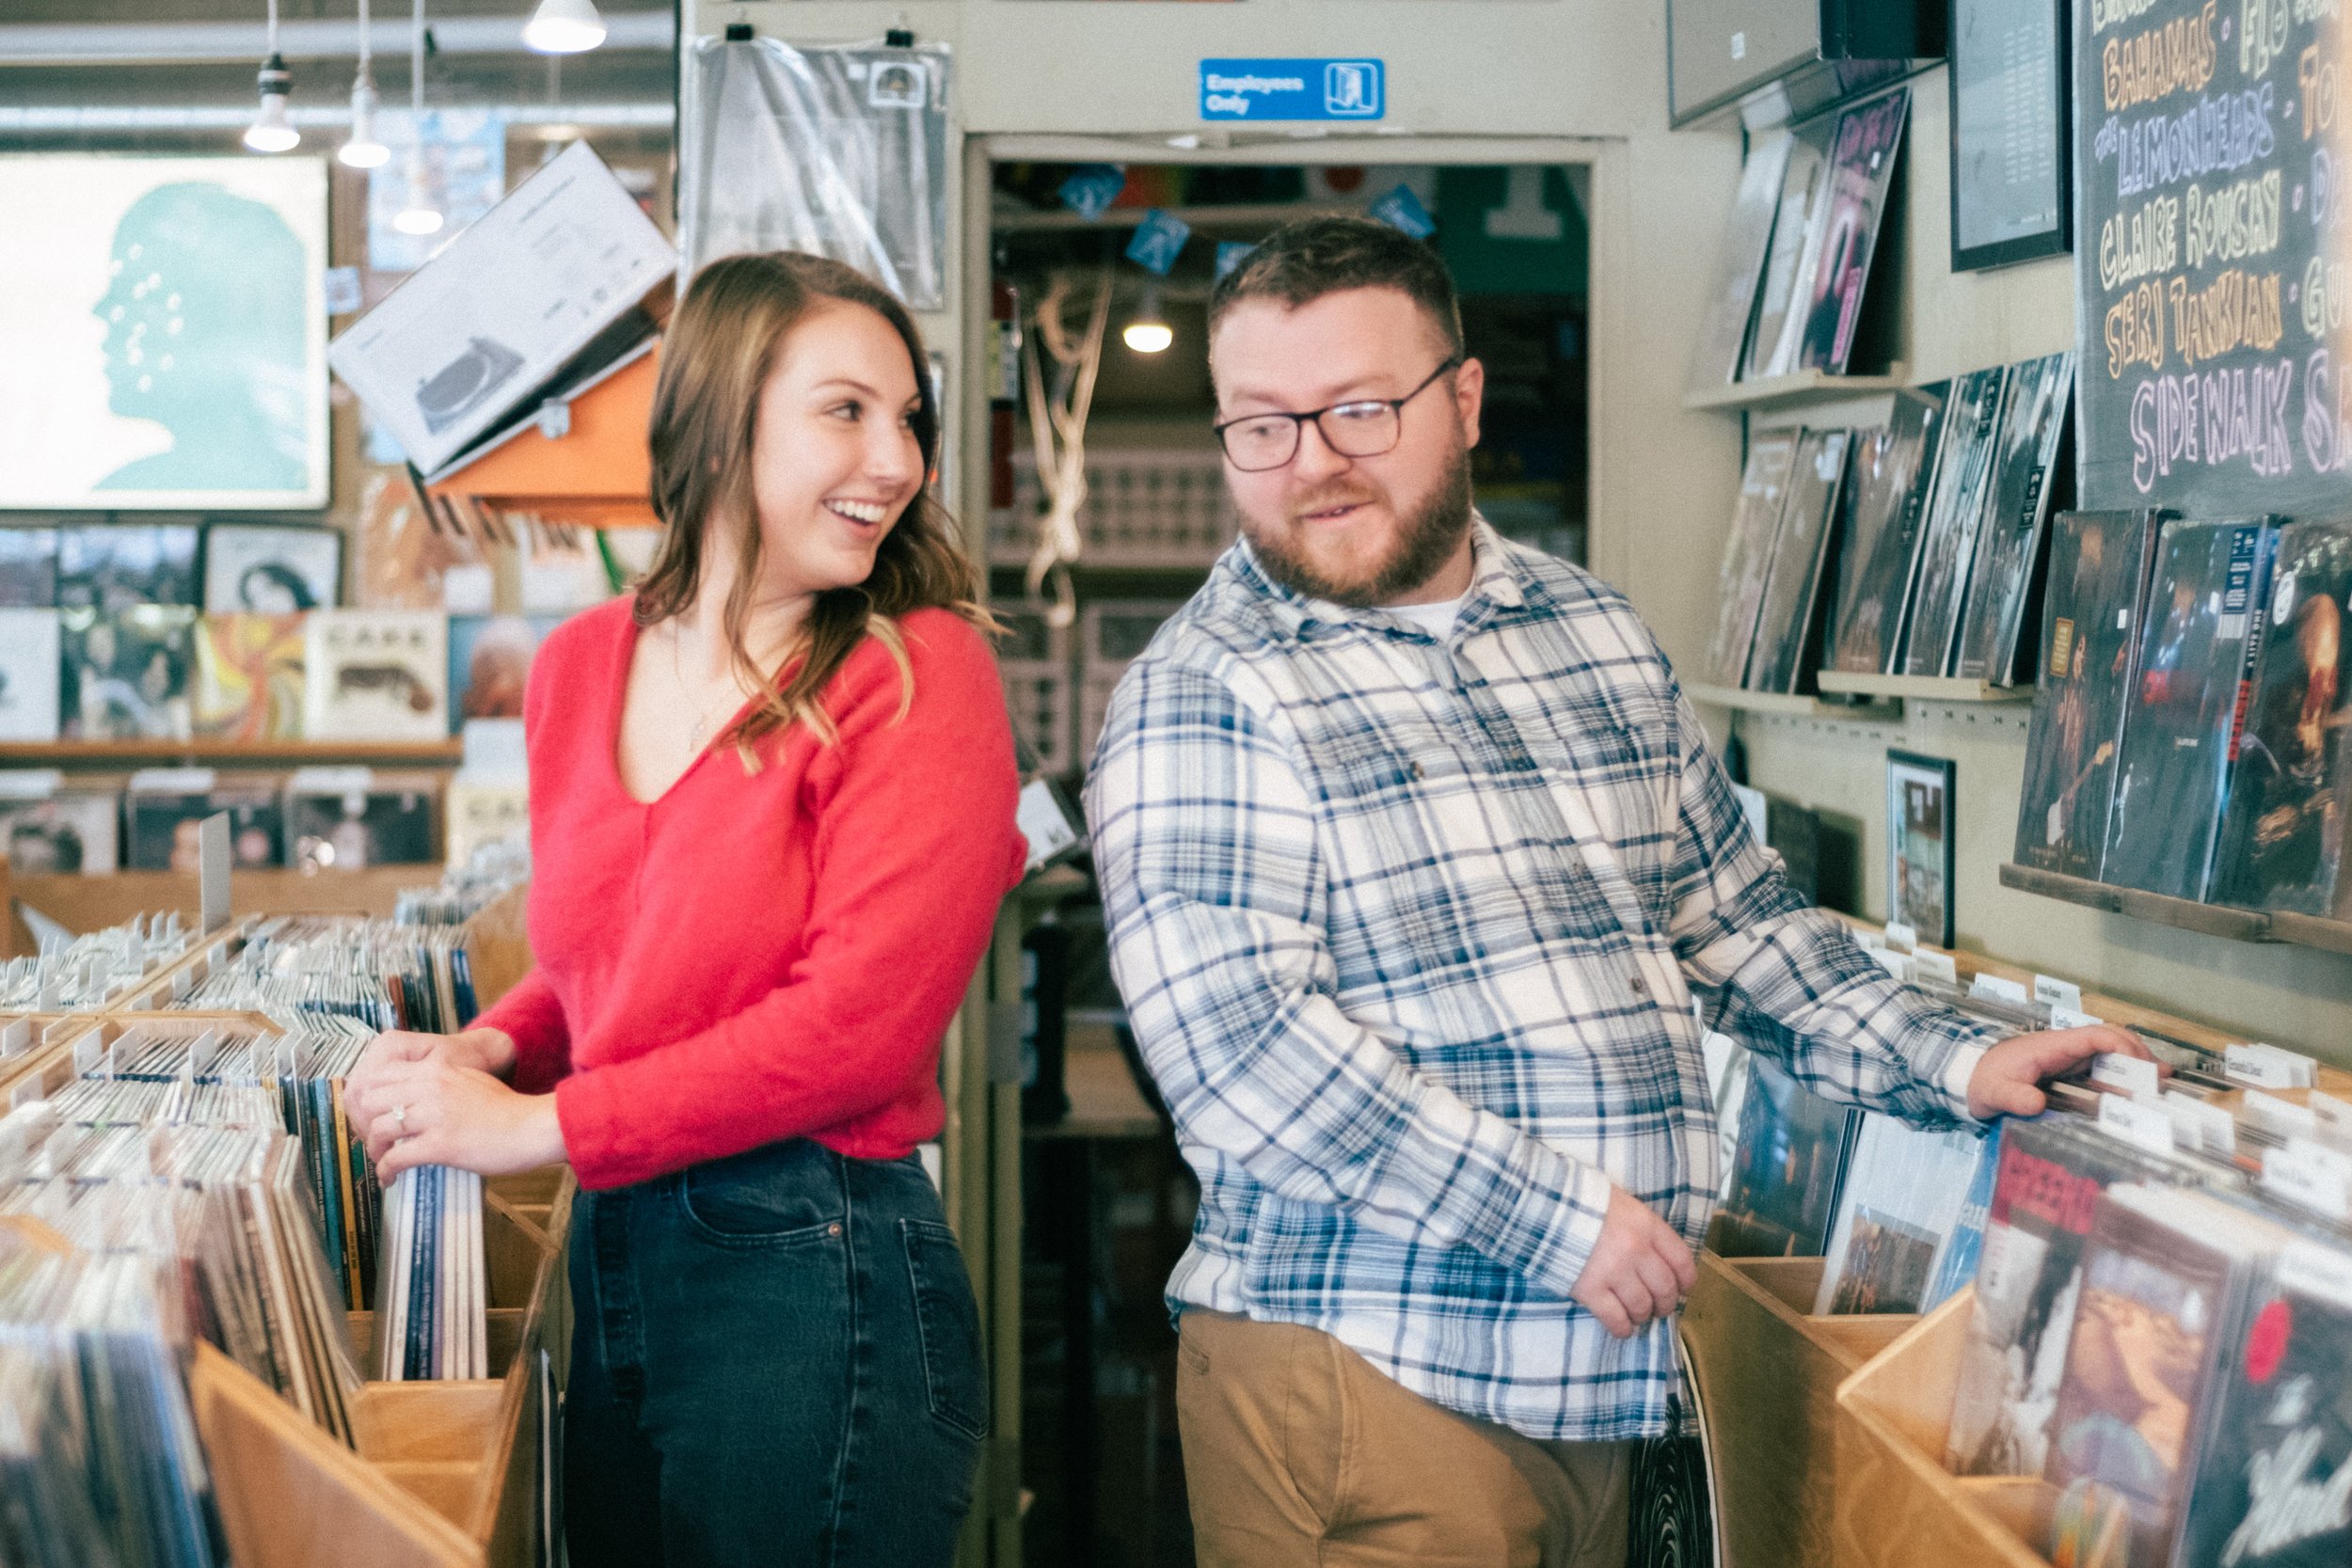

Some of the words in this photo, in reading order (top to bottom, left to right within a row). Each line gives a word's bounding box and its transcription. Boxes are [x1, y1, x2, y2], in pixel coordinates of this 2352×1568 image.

[1205, 73, 1304, 95] Employees
[1205, 94, 1249, 117] Only
[2103, 1, 2217, 112] BAHAMAS
[2118, 81, 2274, 197] LEMONHEADS
[2100, 195, 2178, 292] CLAIRE
[2185, 168, 2281, 269] ROUSAY
[2105, 280, 2164, 379] SERJ
[2169, 269, 2284, 366] TANKIAN
[2129, 356, 2293, 494] SIDEWALK
